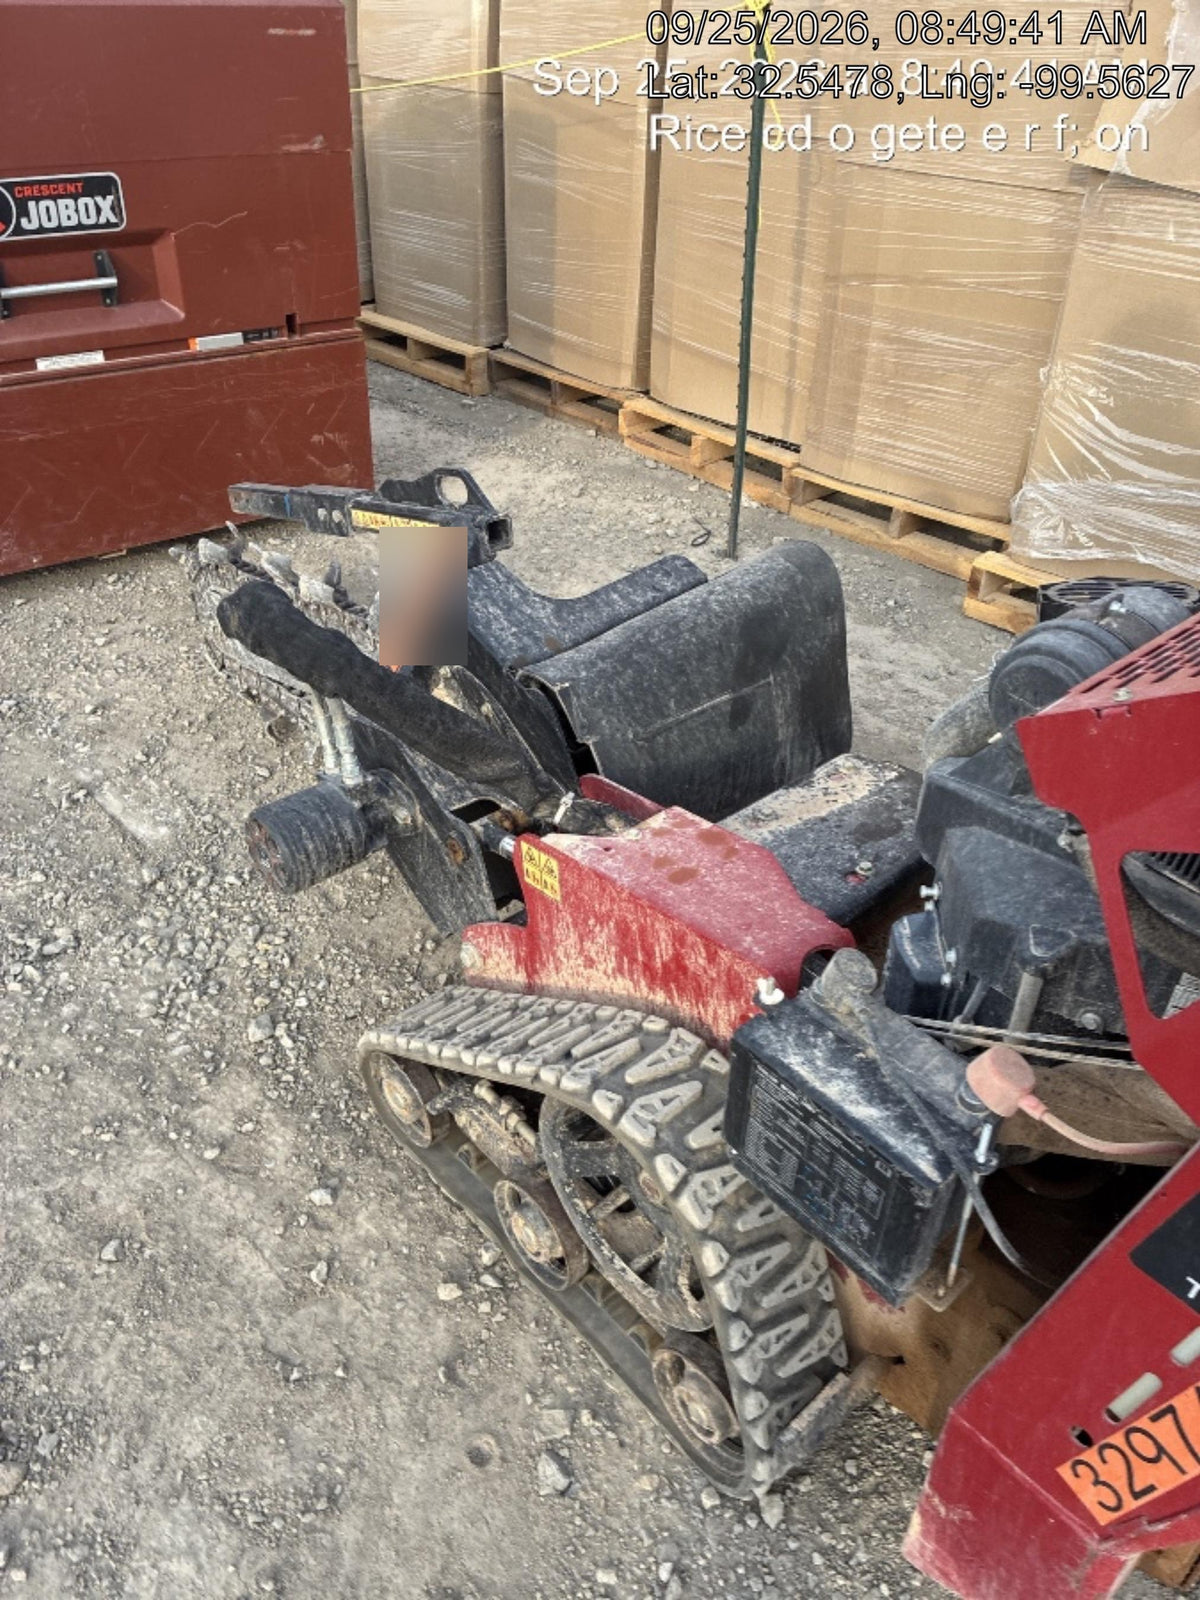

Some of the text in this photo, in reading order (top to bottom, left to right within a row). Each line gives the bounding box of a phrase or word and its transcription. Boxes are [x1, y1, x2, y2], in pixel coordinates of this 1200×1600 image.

[14, 182, 84, 198] CRESCENT
[20, 195, 119, 230] JOBOX
[1069, 1386, 1200, 1513] 3297
